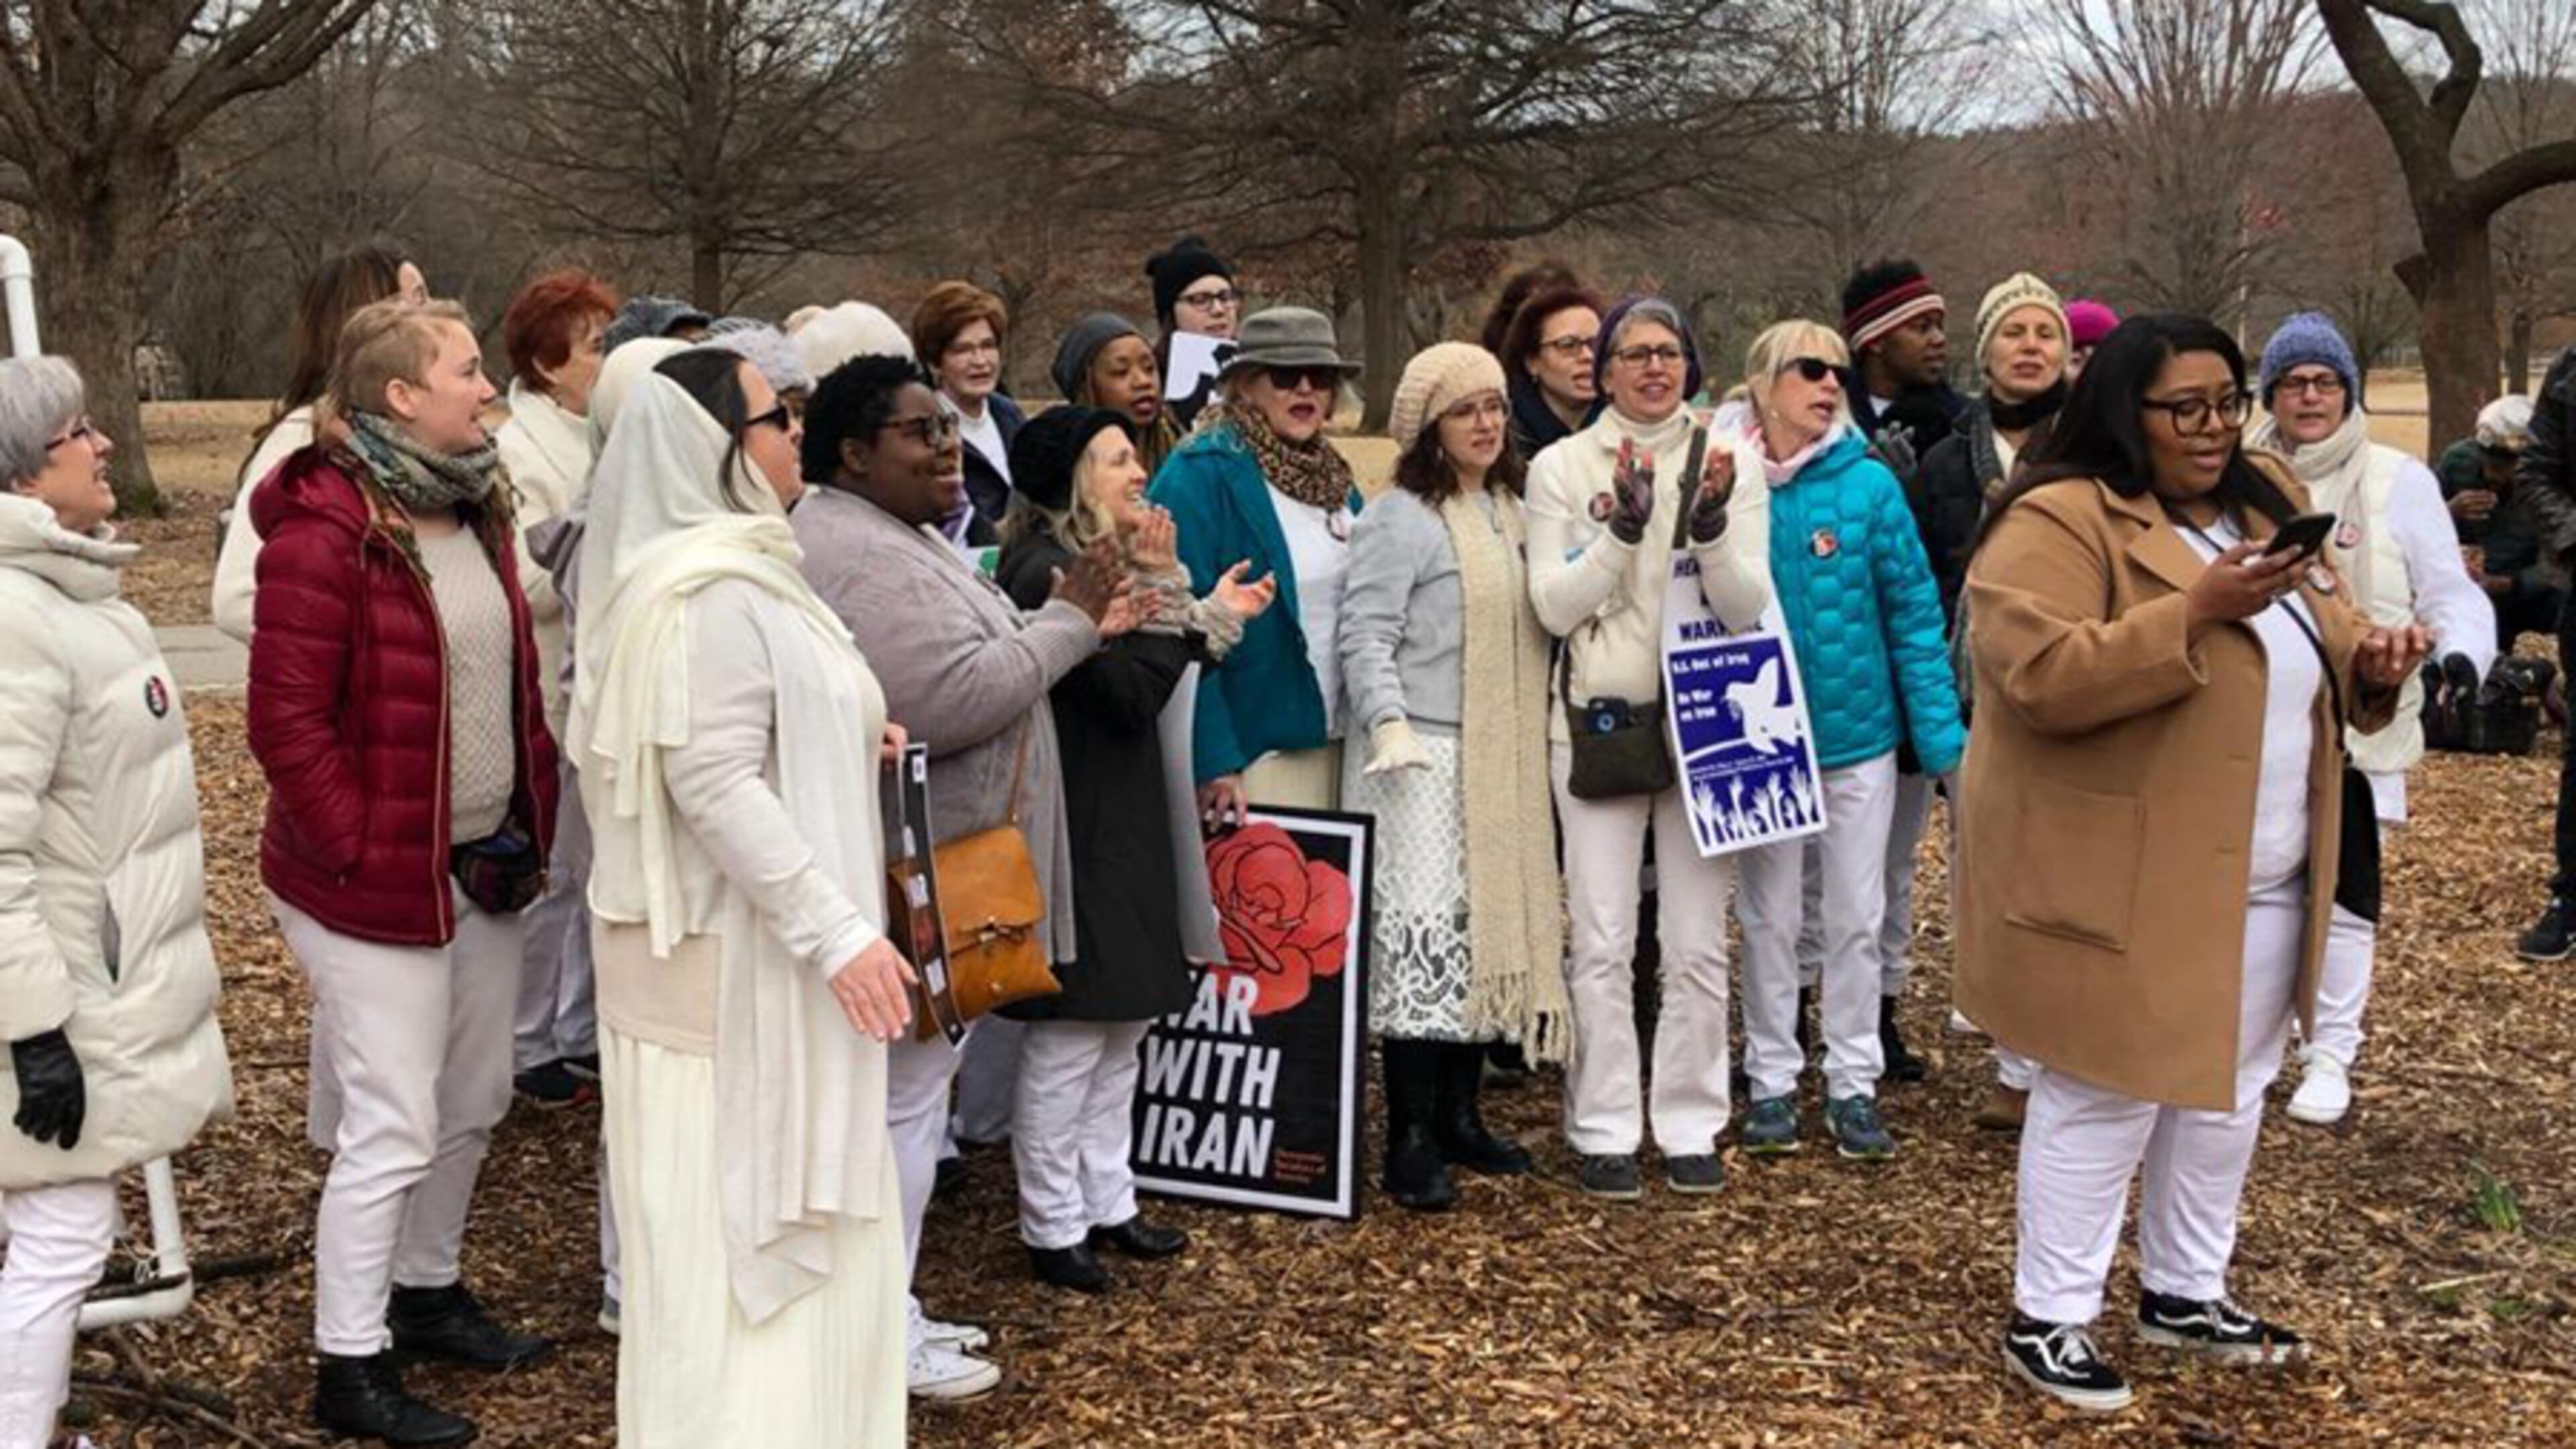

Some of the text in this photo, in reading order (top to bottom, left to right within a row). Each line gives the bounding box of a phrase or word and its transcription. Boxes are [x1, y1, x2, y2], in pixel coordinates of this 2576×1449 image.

[1690, 689, 1713, 703] War
[1149, 972, 1259, 1036] AR
[1144, 1036, 1281, 1108] WITH
[1138, 1104, 1275, 1178] IRAN
